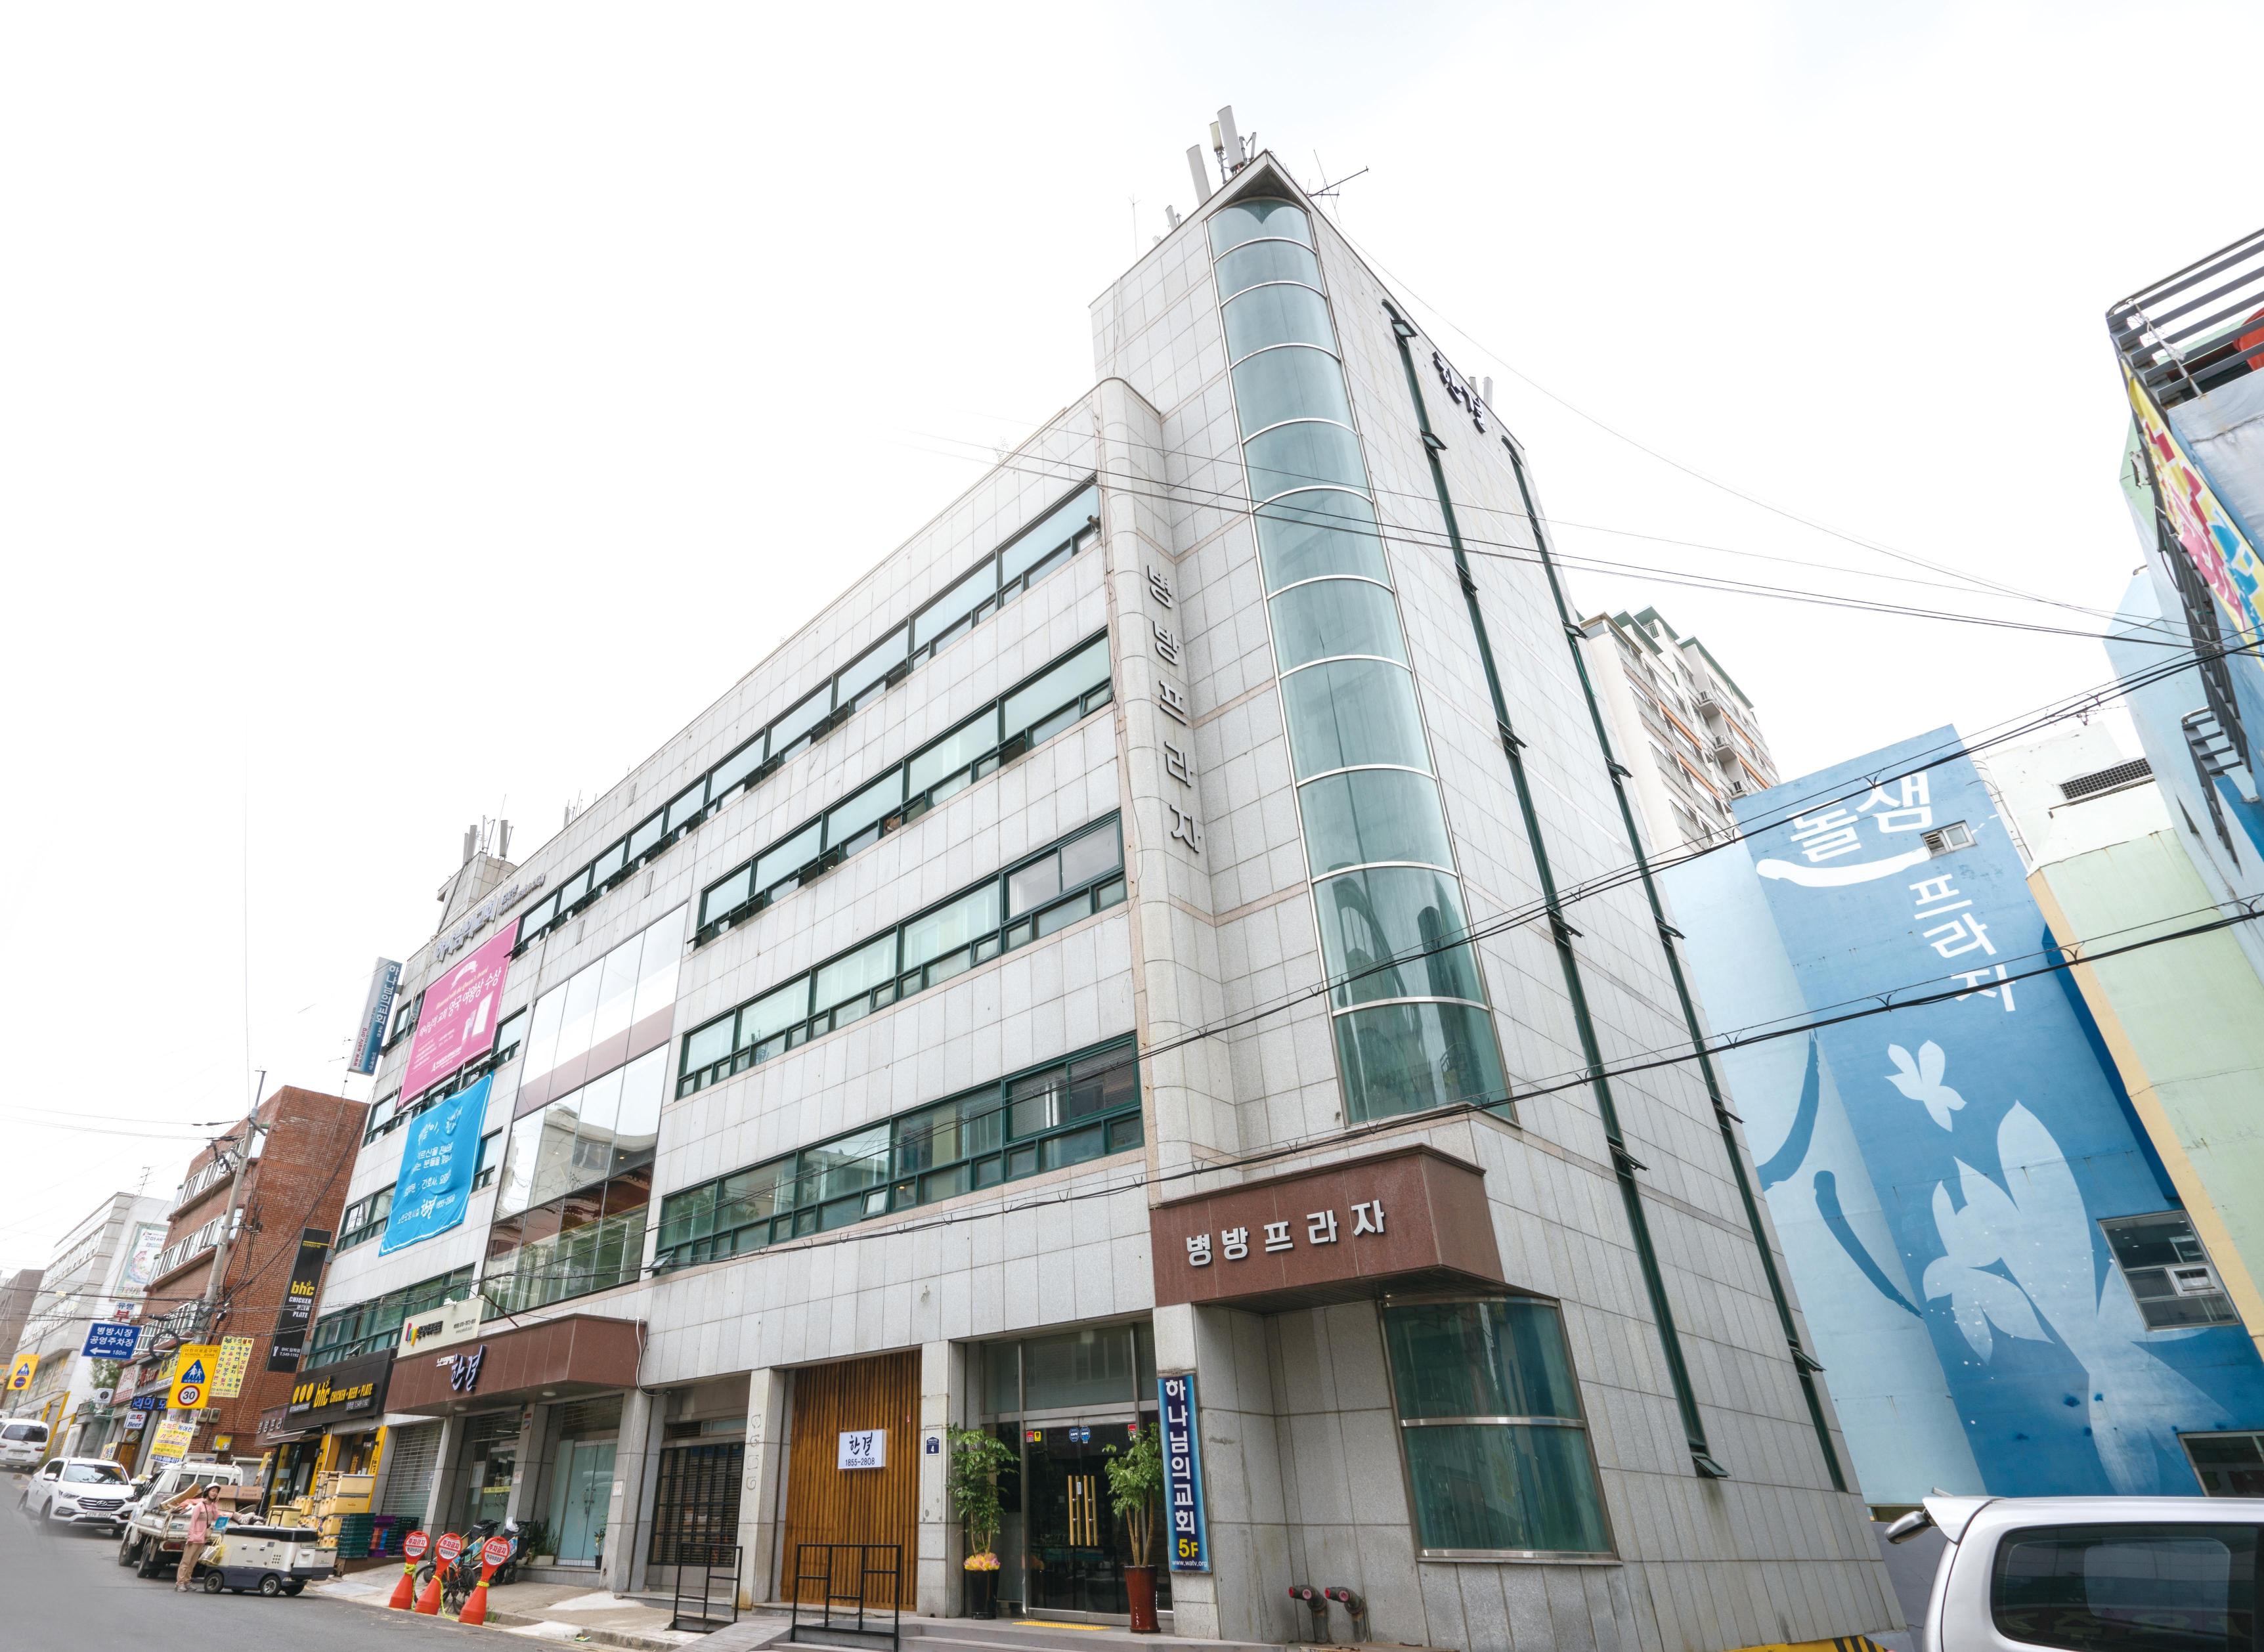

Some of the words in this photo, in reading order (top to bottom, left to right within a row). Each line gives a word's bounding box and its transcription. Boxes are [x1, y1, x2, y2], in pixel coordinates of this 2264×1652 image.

[1146, 565, 1202, 854] 병방프라자
[1785, 772, 1933, 863] 돌샘
[1909, 873, 2016, 1012] 프라자
[485, 967, 502, 990] 수상
[376, 965, 399, 1025] 하나님의교회
[353, 1028, 367, 1066] www.watv.org
[1186, 1200, 1385, 1267] 병방프라자
[291, 1280, 315, 1296] bhc
[90, 1336, 134, 1347] 공영주차장
[97, 1326, 133, 1336] 병방시장
[451, 1345, 487, 1392] 한결
[183, 1391, 195, 1400] 30
[313, 1378, 331, 1408] bhc
[330, 1389, 347, 1404] CHICKEN
[347, 1386, 359, 1400] BEER
[360, 1383, 374, 1397] PLATE
[848, 1432, 873, 1456] 한결
[845, 1457, 875, 1467] 1855-2808
[1165, 1380, 1196, 1535] 하나님의교회
[443, 1540, 460, 1549] 주차금지
[489, 1544, 506, 1554] 주차금지
[1178, 1538, 1199, 1557] 5F
[1171, 1559, 1208, 1568] www.watv.org
